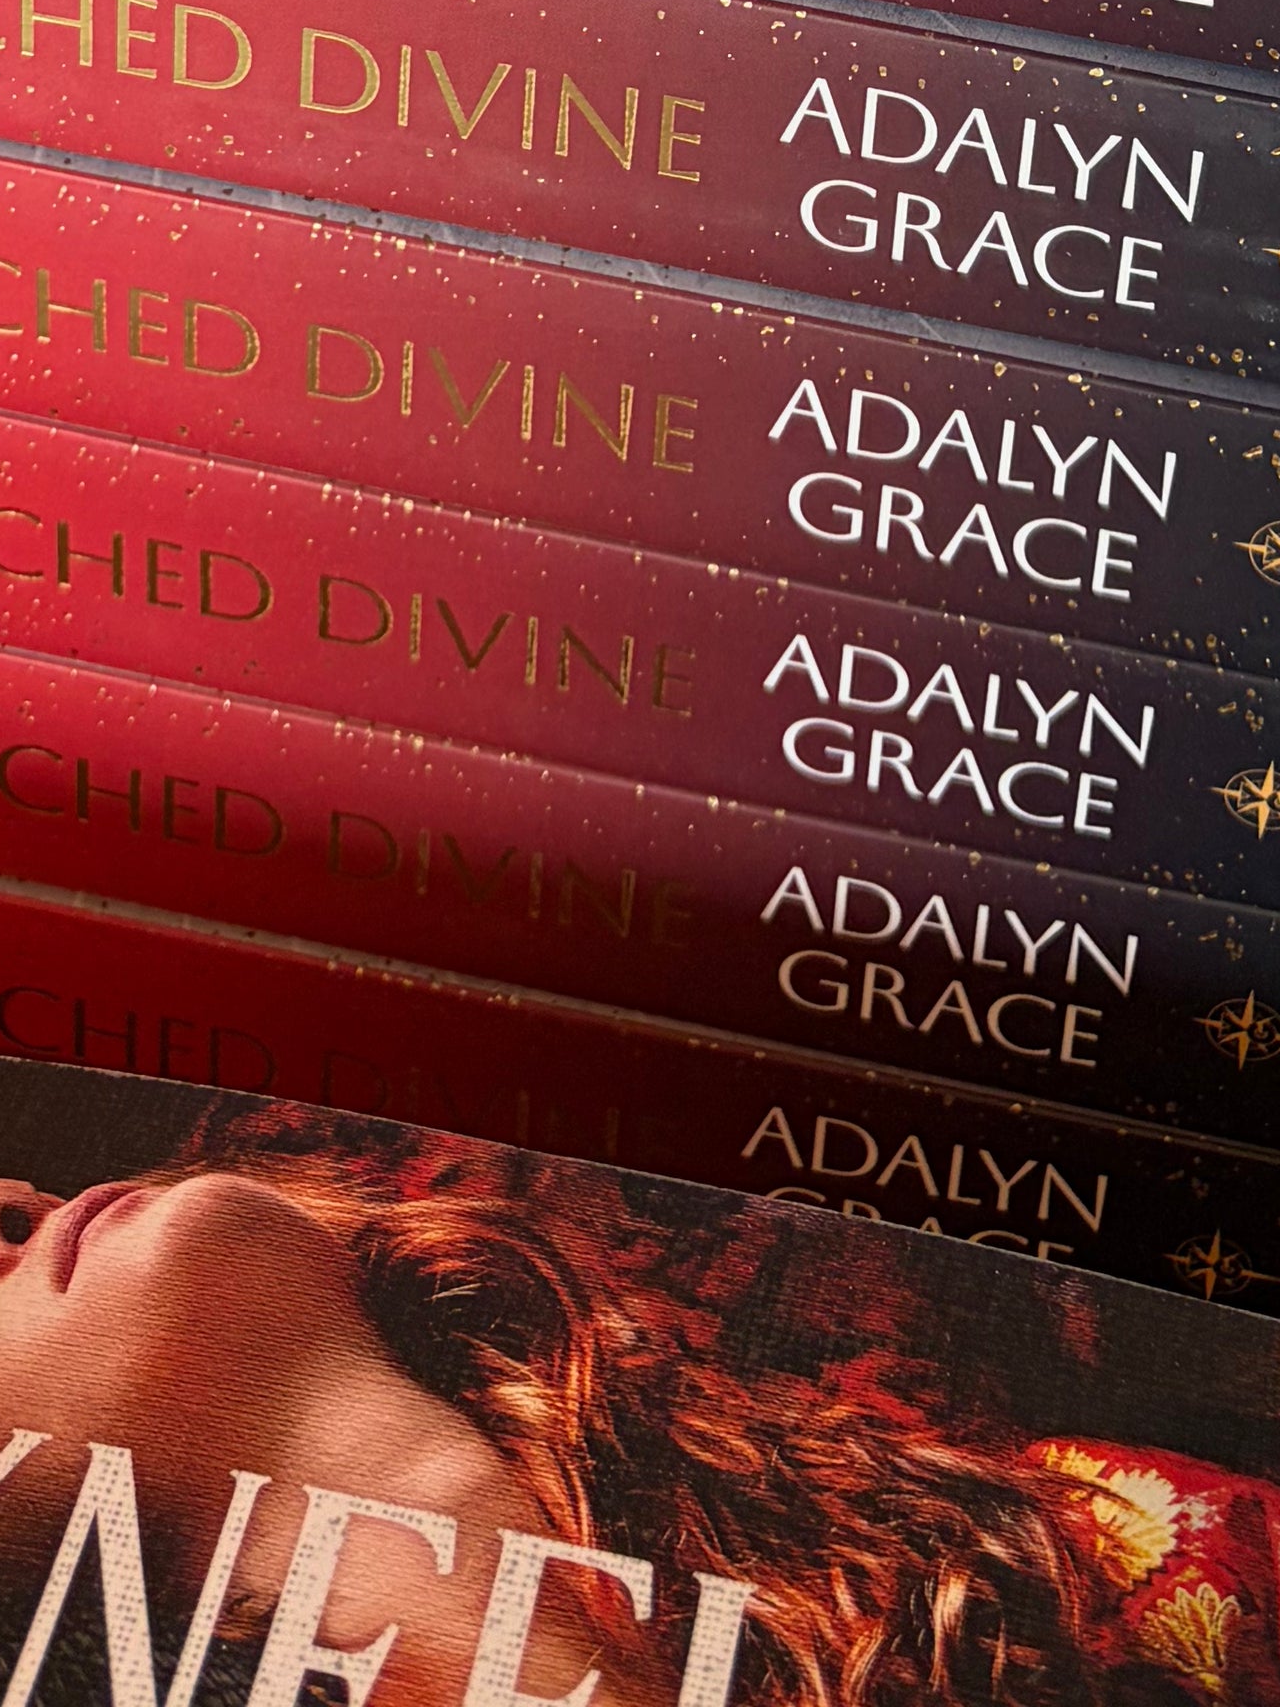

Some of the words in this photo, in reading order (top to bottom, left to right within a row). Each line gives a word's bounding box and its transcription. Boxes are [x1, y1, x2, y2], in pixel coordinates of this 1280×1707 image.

[299, 27, 706, 183] DIVINE
[780, 78, 1204, 223] ADALYN
[800, 179, 1163, 311] GRACE
[306, 324, 700, 473] DIVINE
[769, 378, 1177, 521] ADALYN
[788, 472, 1138, 601] GRACE
[318, 574, 697, 718] DIVINE
[762, 633, 1155, 769] ADALYN
[782, 716, 1119, 839] GRACE
[760, 866, 1139, 996] ADALYN
[778, 950, 1103, 1068] GRACE
[740, 1105, 1109, 1234] ADALYN
